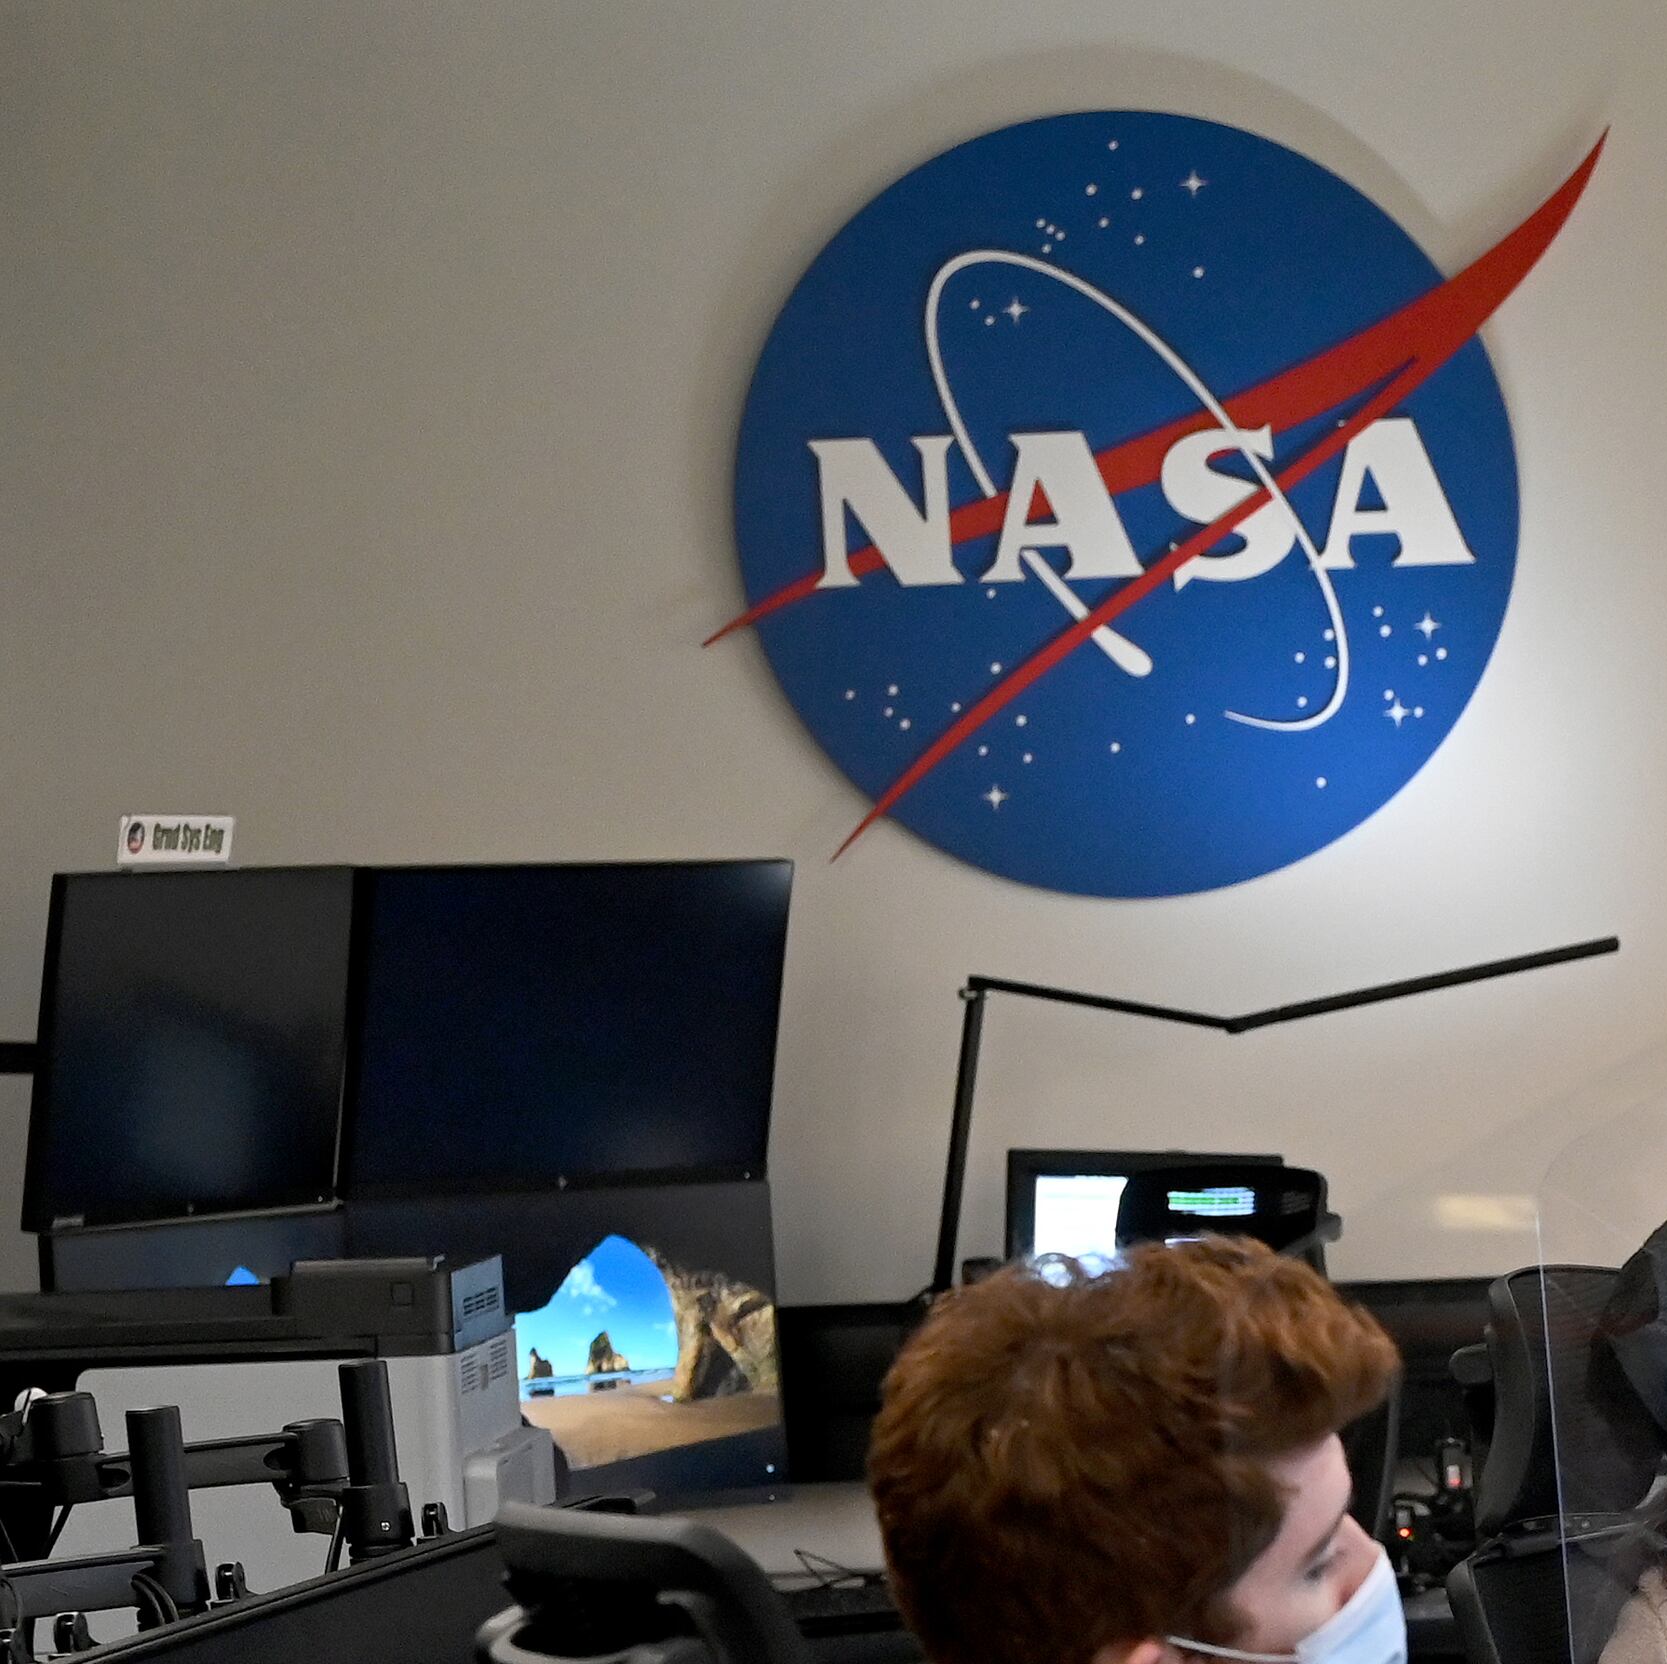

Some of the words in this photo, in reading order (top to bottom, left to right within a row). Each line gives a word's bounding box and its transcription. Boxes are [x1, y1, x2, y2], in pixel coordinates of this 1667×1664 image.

[805, 415, 1477, 593] NASA
[181, 823, 202, 853] Sys
[202, 823, 225, 854] Eng
